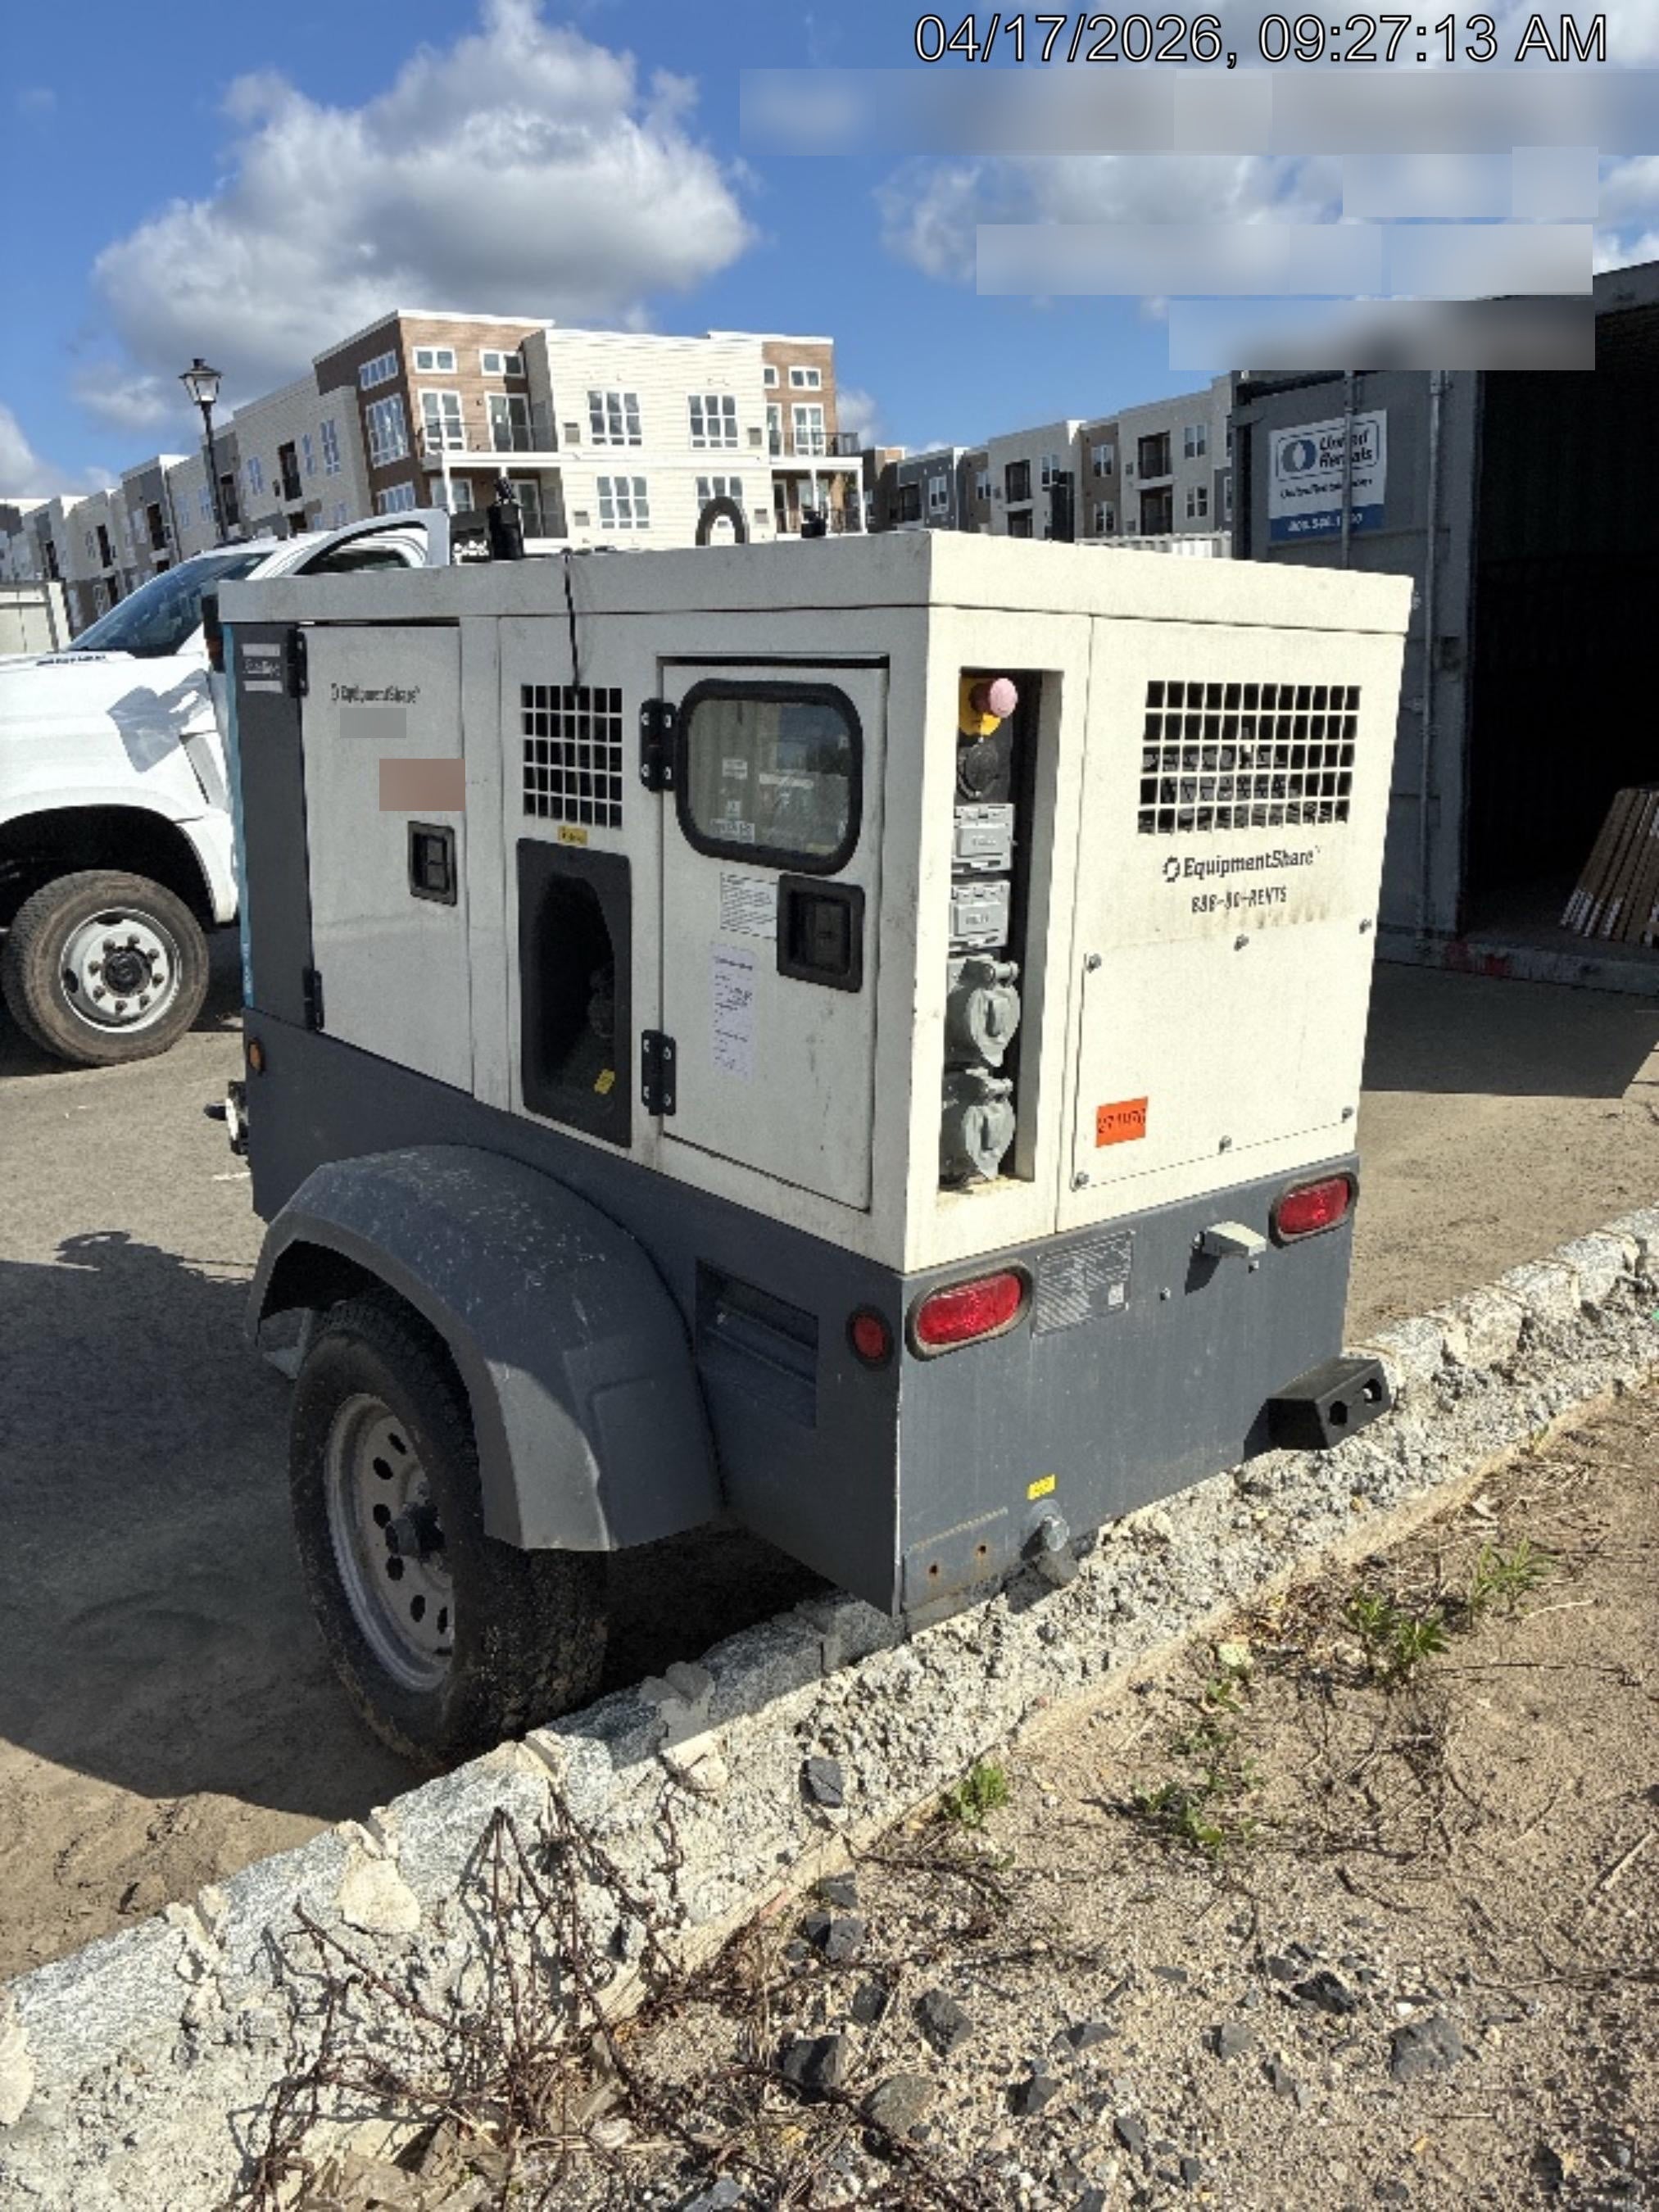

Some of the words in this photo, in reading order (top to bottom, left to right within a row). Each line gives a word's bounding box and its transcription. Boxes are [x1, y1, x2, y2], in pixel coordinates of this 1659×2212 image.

[1320, 428, 1370, 450] Unied
[1320, 447, 1373, 468] Renals
[1183, 850, 1314, 880] EquipmentShare
